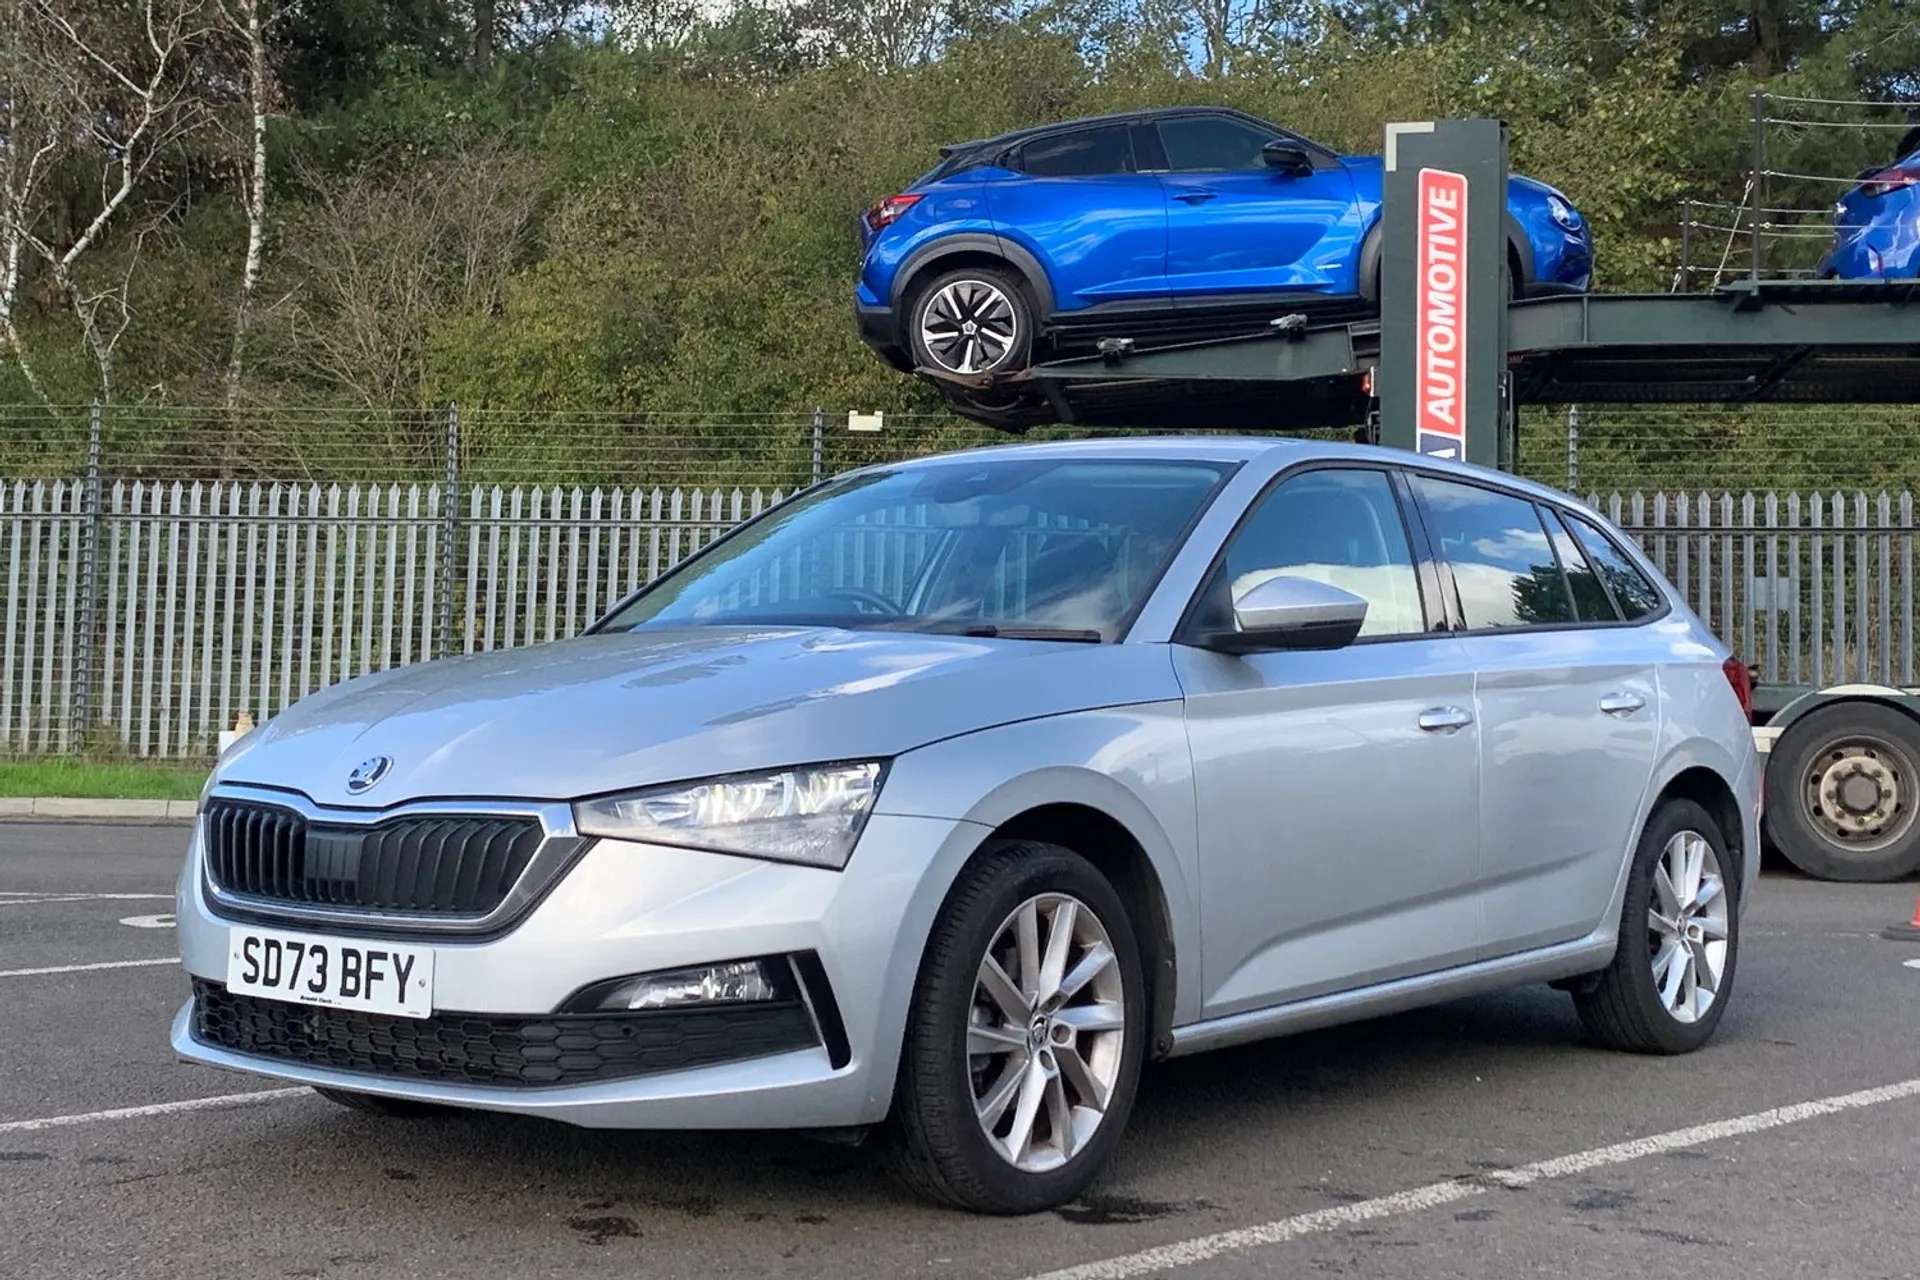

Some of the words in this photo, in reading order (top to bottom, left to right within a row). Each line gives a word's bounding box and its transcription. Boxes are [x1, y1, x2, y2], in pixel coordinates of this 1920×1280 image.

[1427, 185, 1457, 426] AUTOMOTIVE
[242, 936, 329, 993] SD73
[339, 947, 415, 1004] BFY
